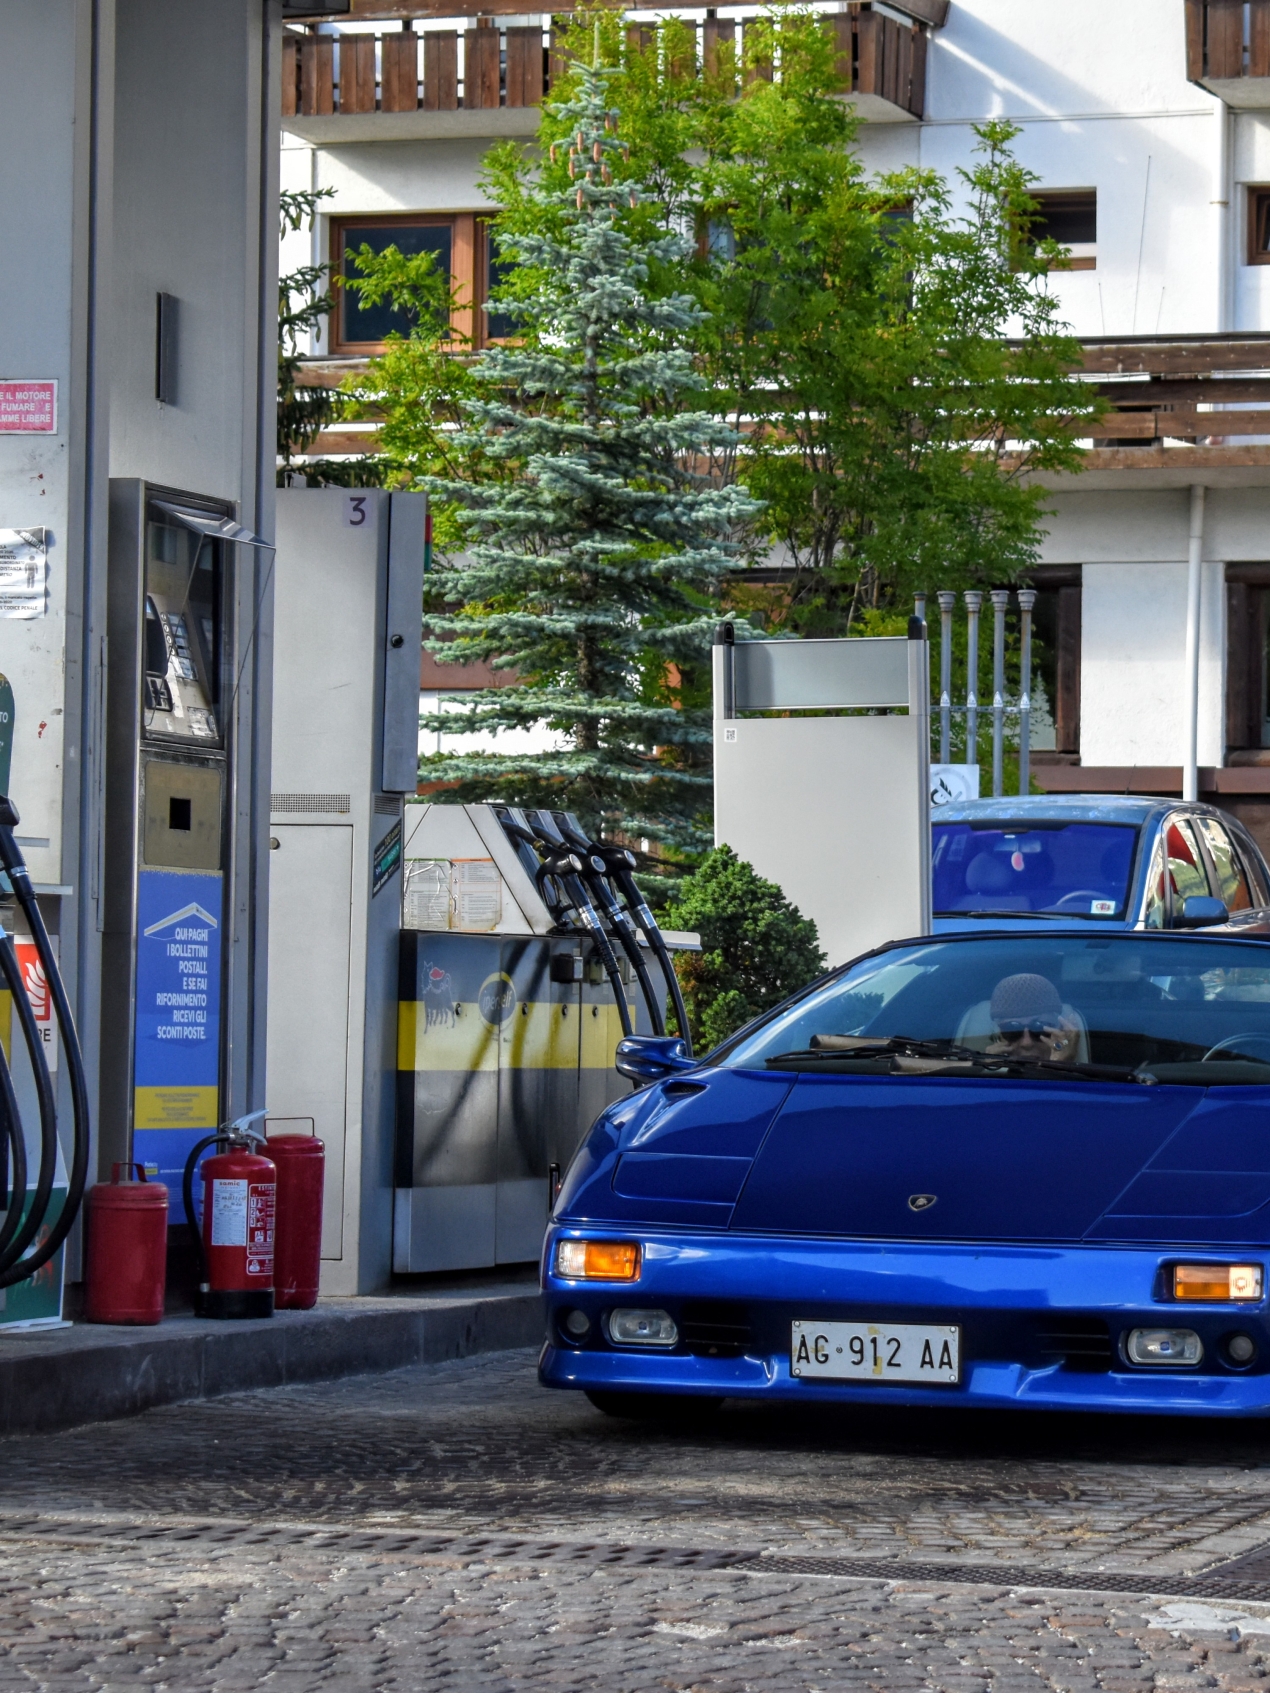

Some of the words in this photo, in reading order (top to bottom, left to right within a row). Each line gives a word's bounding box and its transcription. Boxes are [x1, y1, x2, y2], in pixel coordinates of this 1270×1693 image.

[6, 391, 14, 400] IL
[15, 391, 51, 400] MOTORE
[1, 402, 36, 411] FUMARE
[45, 402, 51, 411] E
[22, 414, 51, 423] LIBERE
[349, 497, 366, 526] 3
[175, 927, 187, 940] QUI
[188, 928, 208, 941] PAGHI
[171, 944, 208, 957] BOLLETTINI
[179, 960, 207, 974] POSTALI.
[183, 977, 187, 990] E
[188, 977, 196, 990] SE
[196, 978, 207, 990] FAI
[156, 993, 206, 1006] RIFORNIMENTO
[173, 1009, 195, 1022] RICEVI
[195, 1010, 206, 1023] GLI
[157, 1026, 183, 1039] SCONTI
[183, 1026, 206, 1039] POSTE.
[796, 1333, 829, 1364] AG
[849, 1335, 902, 1367] 912
[919, 1338, 953, 1369] AA
